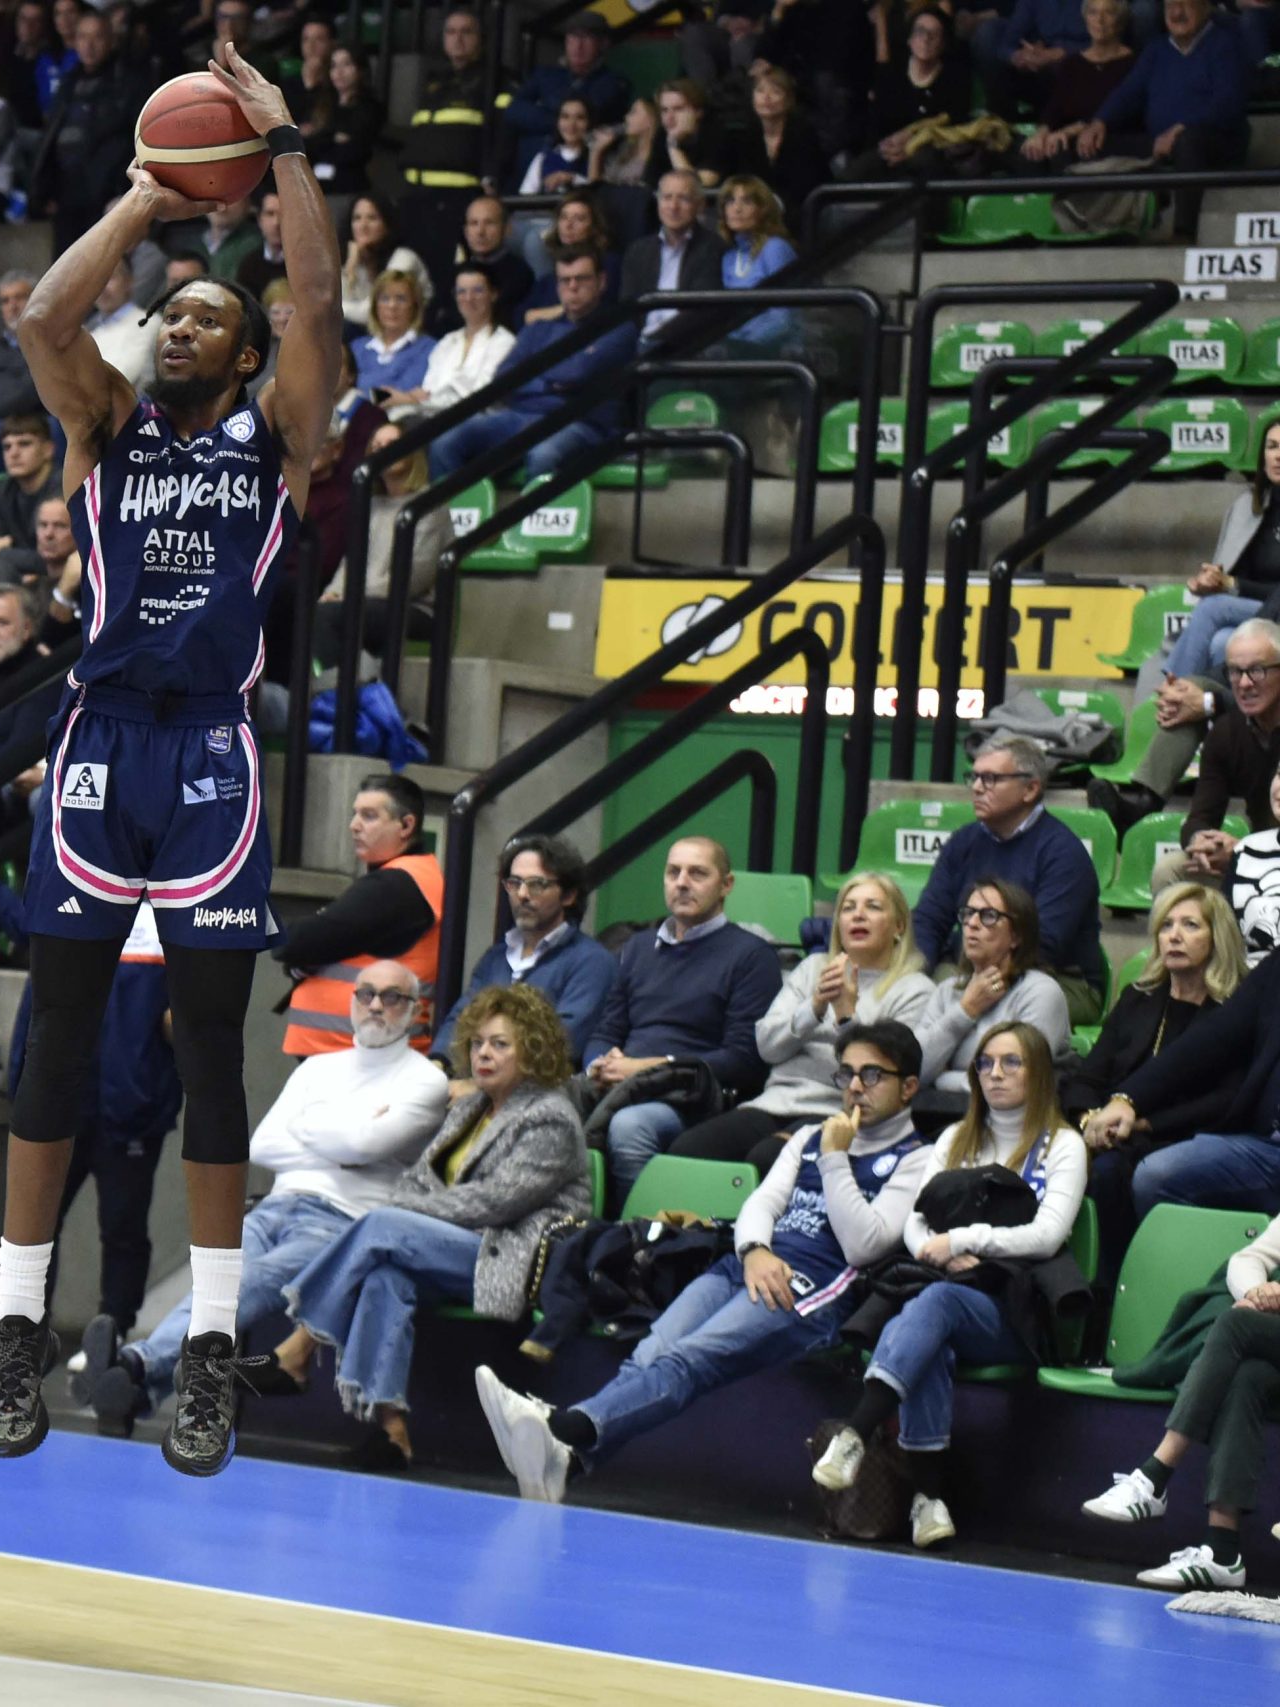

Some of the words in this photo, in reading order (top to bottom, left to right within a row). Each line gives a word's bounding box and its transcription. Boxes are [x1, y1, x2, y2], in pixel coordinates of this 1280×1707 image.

[1198, 254, 1263, 276] ITLAS
[1175, 344, 1219, 360] ITLAS
[1178, 427, 1224, 442] ITLAS
[243, 453, 260, 463] SUD
[143, 527, 216, 553] ATTAL
[143, 550, 216, 567] GROUP
[140, 597, 207, 611] PRIMICERI
[209, 728, 229, 739] LBA
[65, 797, 101, 808] habitat
[903, 834, 943, 852] ITLA
